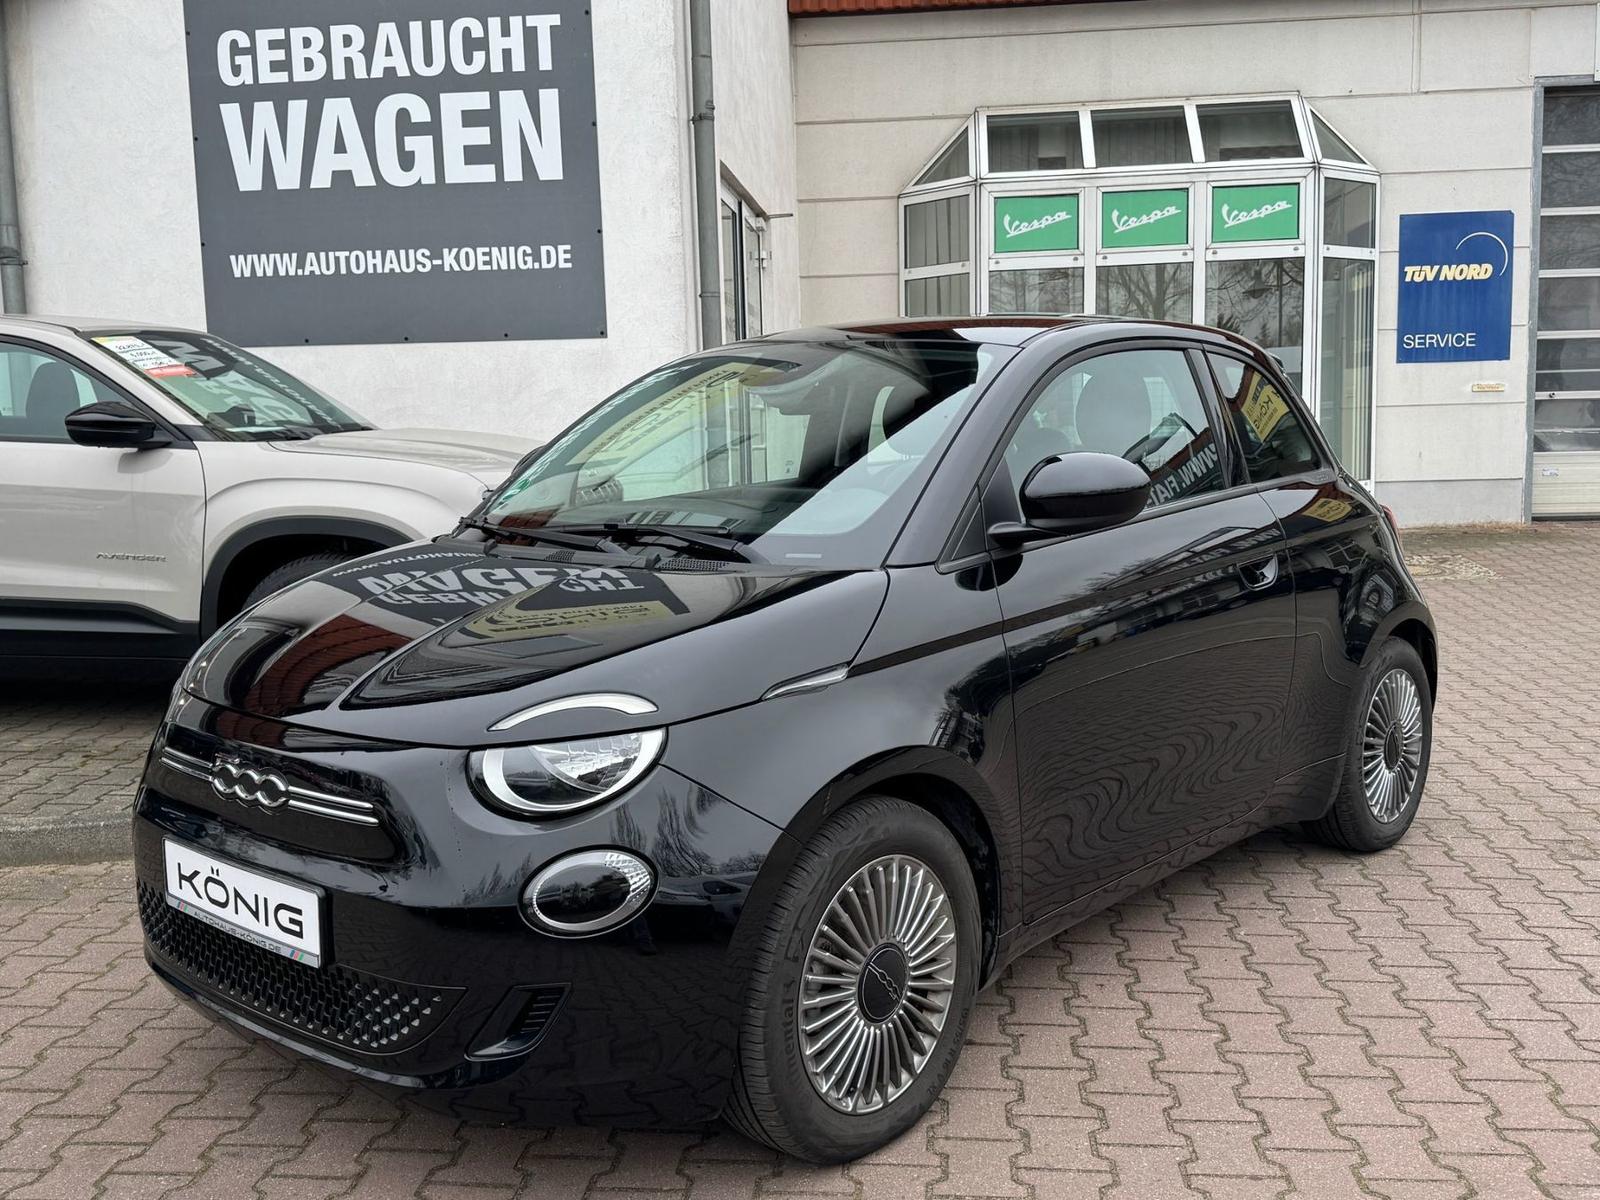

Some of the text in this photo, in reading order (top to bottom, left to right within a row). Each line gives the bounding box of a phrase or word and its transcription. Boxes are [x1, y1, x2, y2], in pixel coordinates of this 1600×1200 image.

[216, 13, 562, 87] GEBRAUCHT
[218, 87, 564, 192] WAGEN
[1003, 211, 1072, 238] Vespa
[1112, 205, 1182, 233] Vespa
[1222, 200, 1293, 228] Vespa
[229, 244, 573, 278] WWW.AUTOHAUS-KOENIG.DE
[1403, 263, 1494, 283] TÜV NORD
[1402, 333, 1477, 349] SERVICE
[96, 552, 166, 562] AVENGER
[177, 861, 304, 940] KÖNIG
